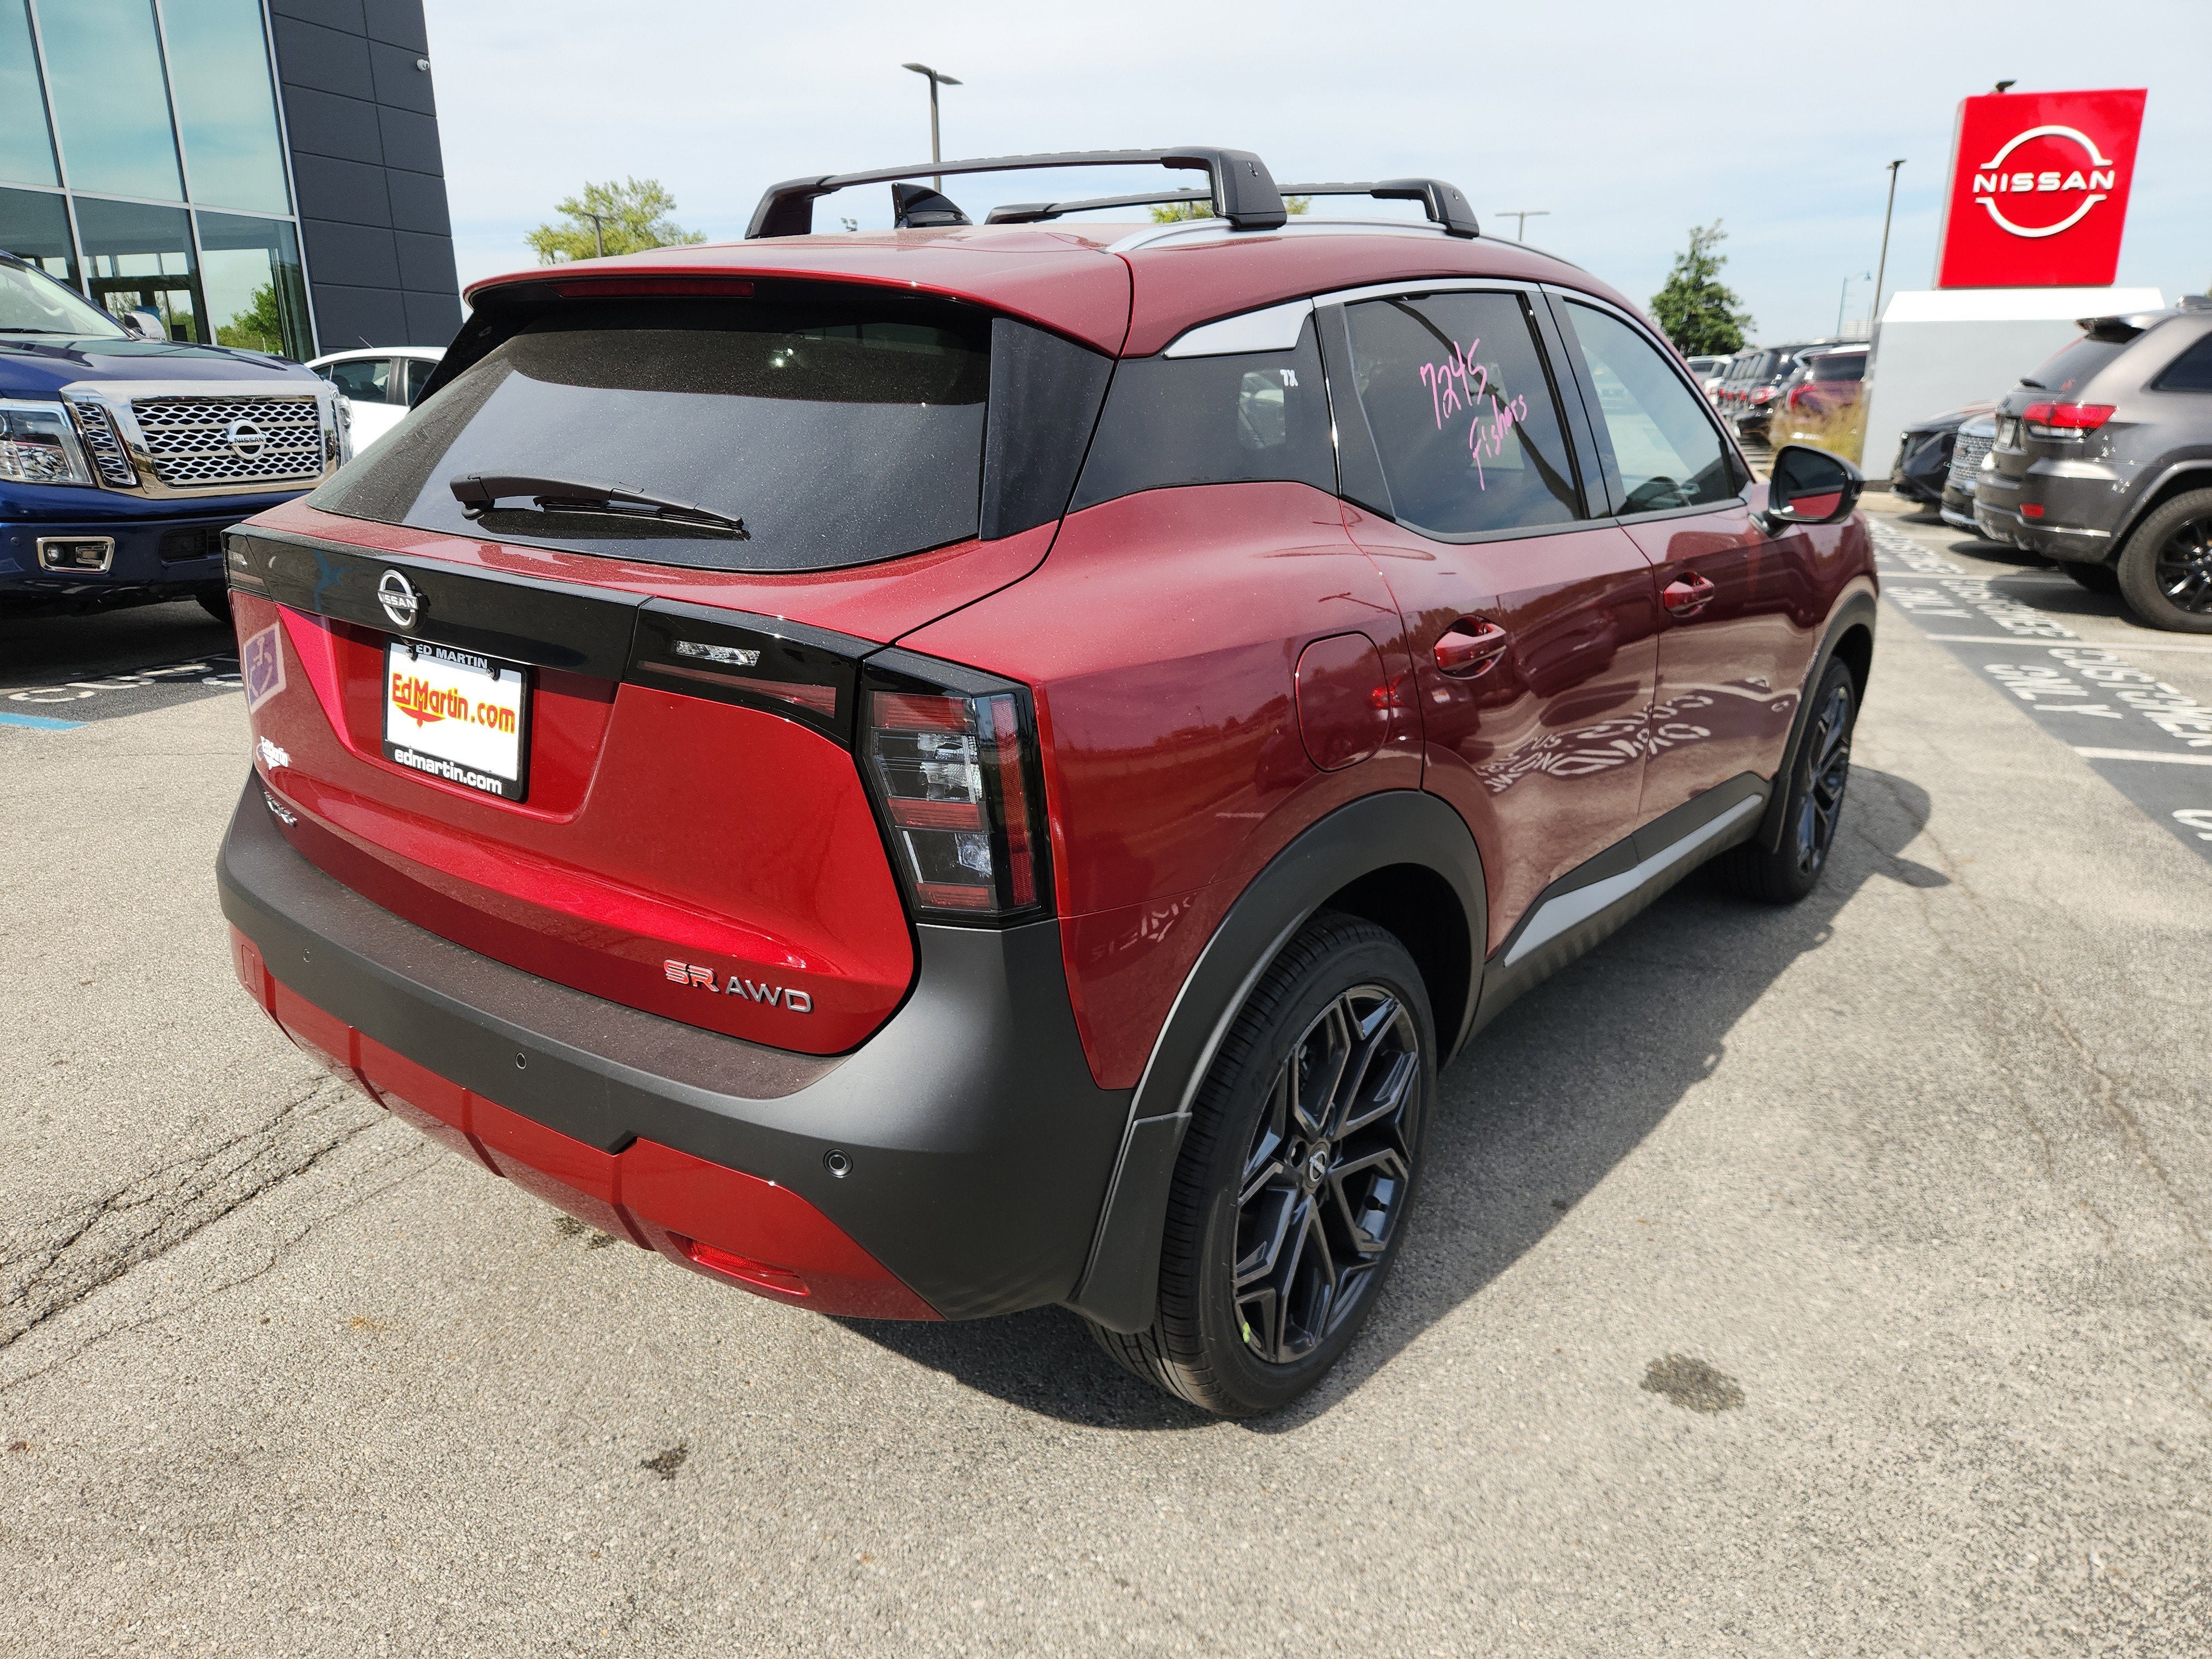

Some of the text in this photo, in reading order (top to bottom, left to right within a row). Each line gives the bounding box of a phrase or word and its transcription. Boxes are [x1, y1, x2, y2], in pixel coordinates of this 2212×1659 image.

[1972, 170, 2115, 193] NISSAN
[1419, 338, 1488, 430] 7245
[377, 593, 417, 609] NISSAN
[416, 644, 487, 669] ED MARTIN
[394, 748, 503, 795] edmartin.com
[664, 959, 812, 1014] SR AWD
